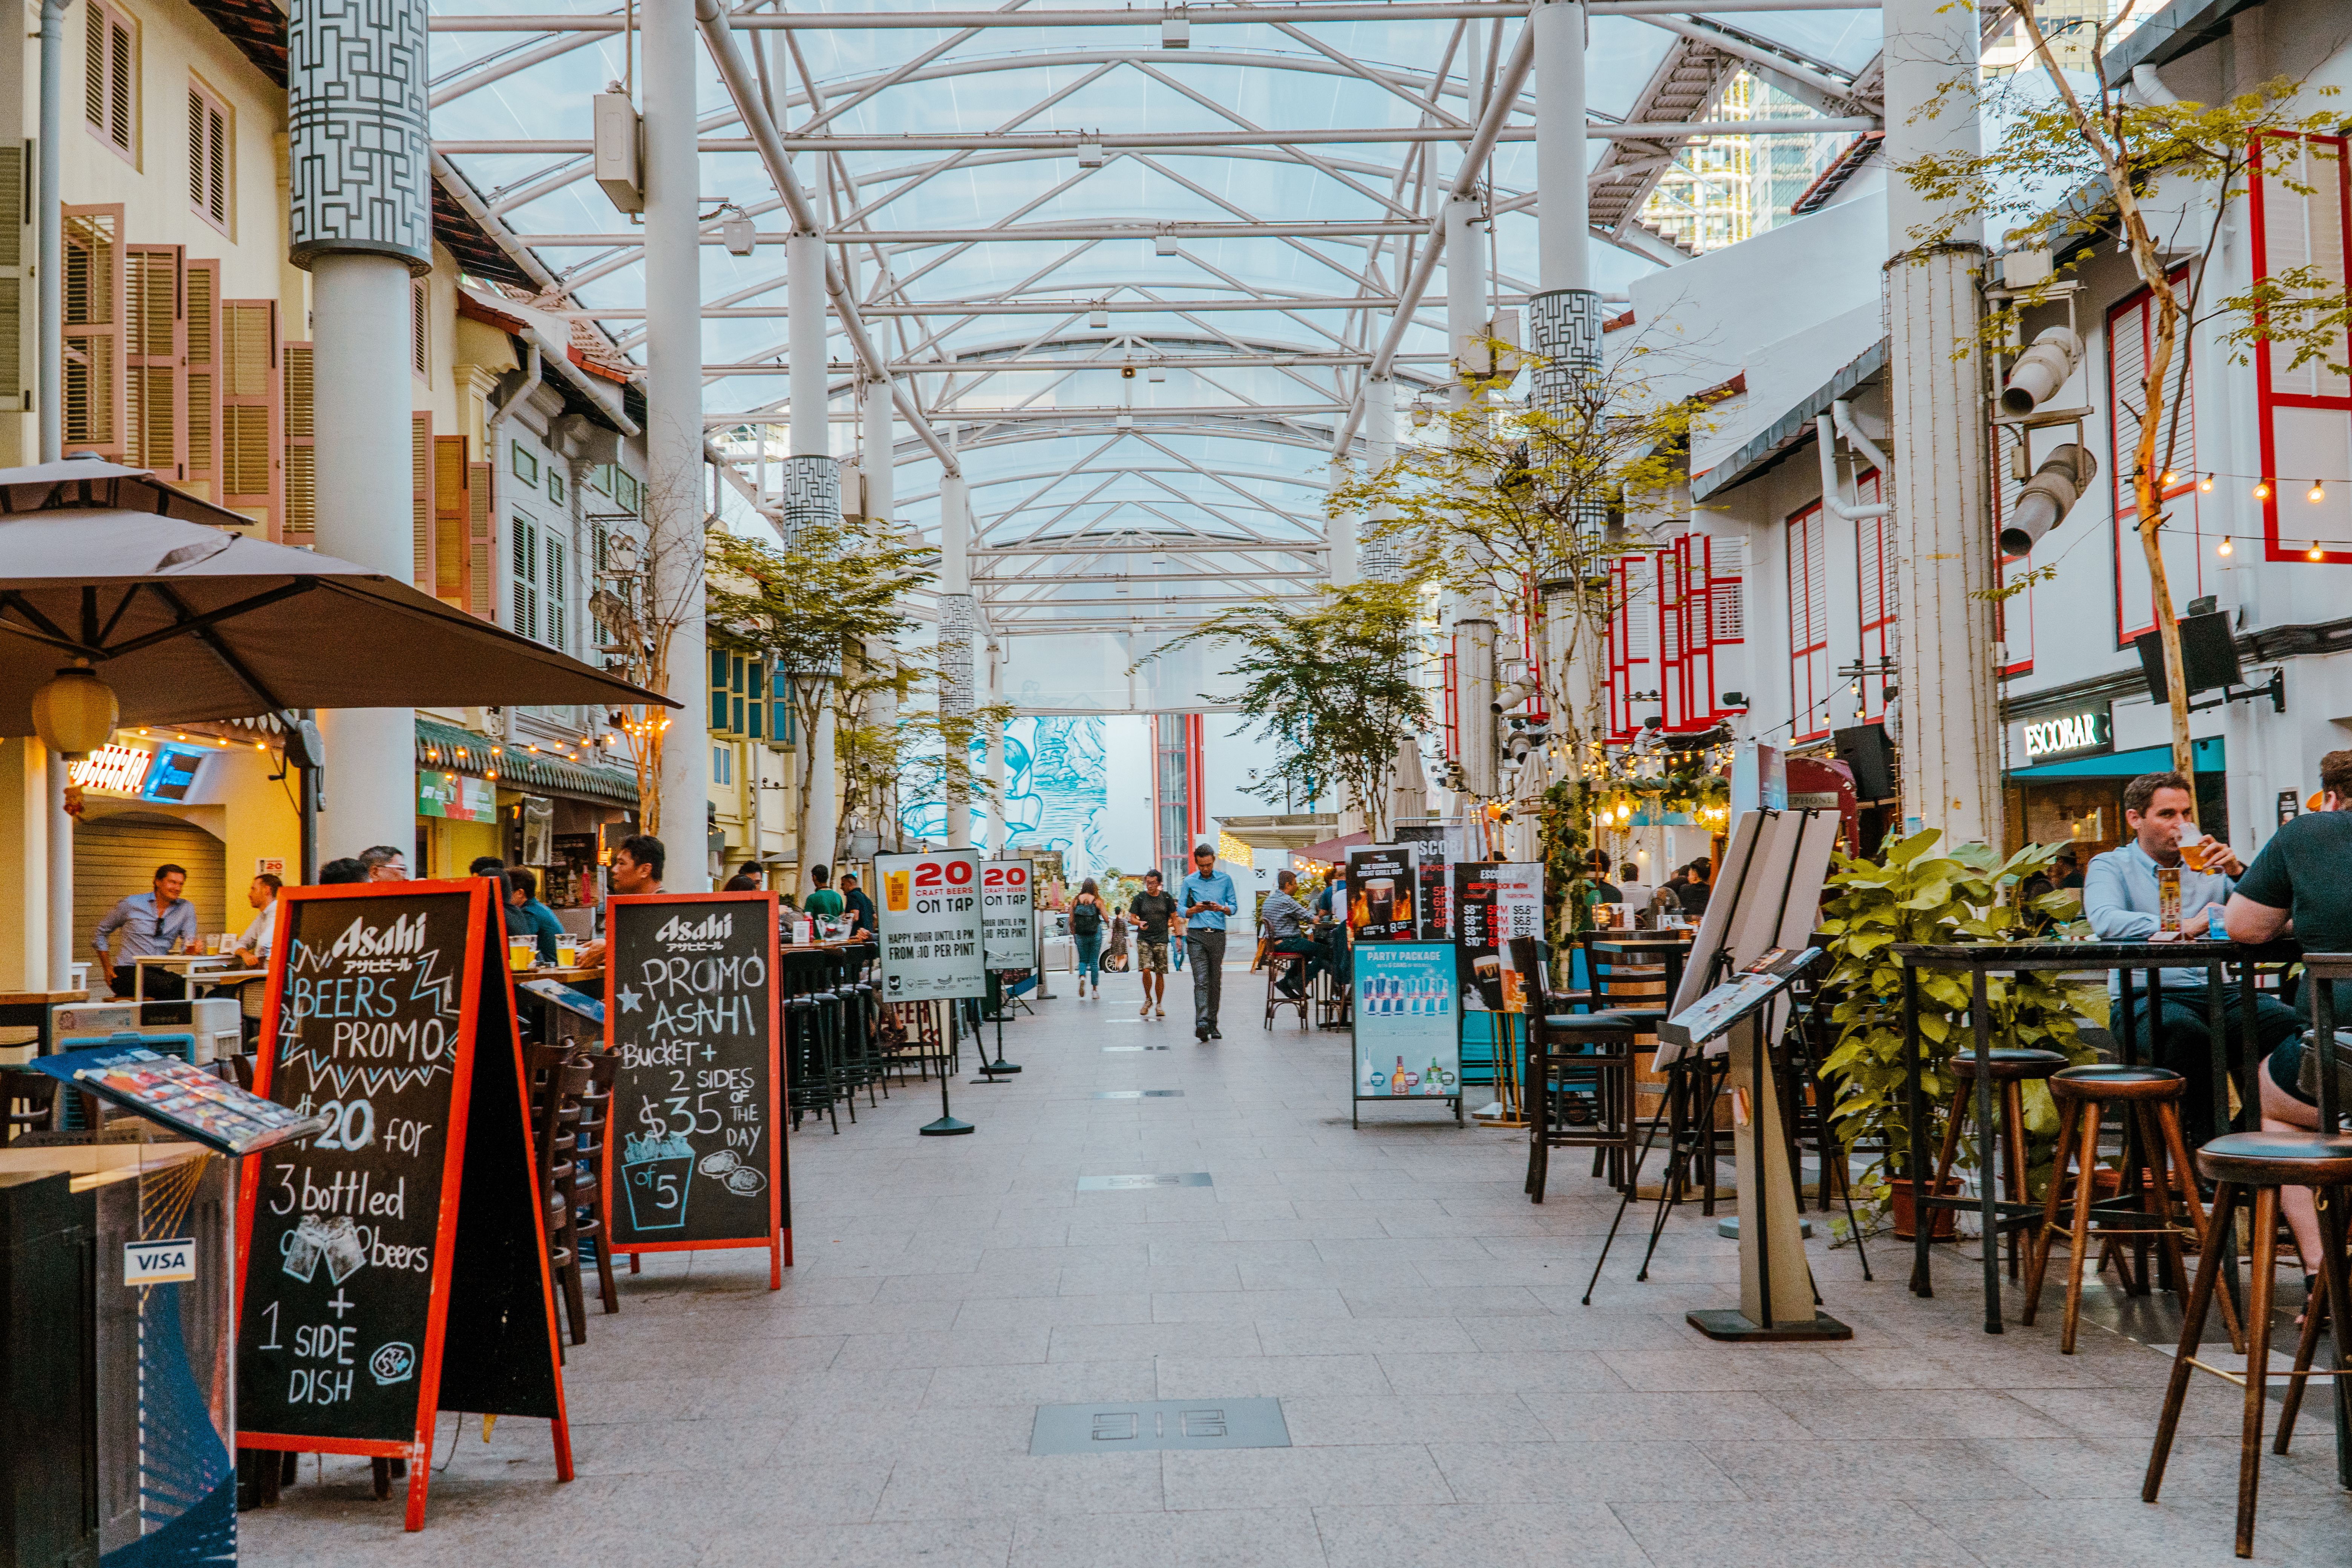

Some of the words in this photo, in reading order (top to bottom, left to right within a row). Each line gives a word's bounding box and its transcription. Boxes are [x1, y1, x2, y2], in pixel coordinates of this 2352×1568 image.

[2024, 714, 2098, 755] ESCOBAR
[915, 861, 972, 887] 20
[985, 868, 1026, 886] 20
[1481, 870, 1516, 879] ESCOBAR
[916, 899, 940, 913] ON
[946, 897, 974, 912] TAP
[985, 896, 1002, 905] ON
[1007, 895, 1026, 905] TAP
[1487, 905, 1508, 914] 5PM
[655, 913, 732, 943] Asahi
[1487, 916, 1508, 925] 6PM
[1488, 926, 1508, 936] 7PM
[331, 912, 426, 958] Asahi
[888, 933, 911, 944] HAPPY
[913, 932, 933, 942] HOUR
[934, 930, 955, 941] UNTIL
[963, 929, 974, 939] PM
[997, 928, 1009, 938] PER
[1488, 937, 1508, 947] 8PM
[666, 941, 724, 953] アサヒビール
[889, 946, 914, 960] FROM
[934, 944, 951, 957] PER
[954, 943, 975, 956] PINT
[1367, 952, 1397, 961] PARTY
[1399, 951, 1441, 960] PACKAGE
[343, 957, 412, 974] アサヒビール
[641, 956, 765, 1001] PROMO
[293, 976, 397, 1018] BEERS
[647, 994, 756, 1042] ASAHI
[333, 1018, 444, 1063] PROMO
[669, 1070, 691, 1091] 2
[697, 1067, 755, 1089] SIDES
[730, 1089, 750, 1103] OF
[639, 1091, 722, 1144] $35
[730, 1104, 759, 1121] THE
[383, 1118, 432, 1157] for
[726, 1125, 762, 1156] DAY
[634, 1164, 657, 1189] of
[270, 1164, 295, 1215] 3
[302, 1167, 404, 1219] bottled
[655, 1174, 678, 1210] 5
[136, 1252, 186, 1271] VISA
[371, 1226, 429, 1273] beers
[259, 1301, 283, 1350] 1
[294, 1324, 357, 1365] SIDE
[288, 1369, 354, 1406] DISH
